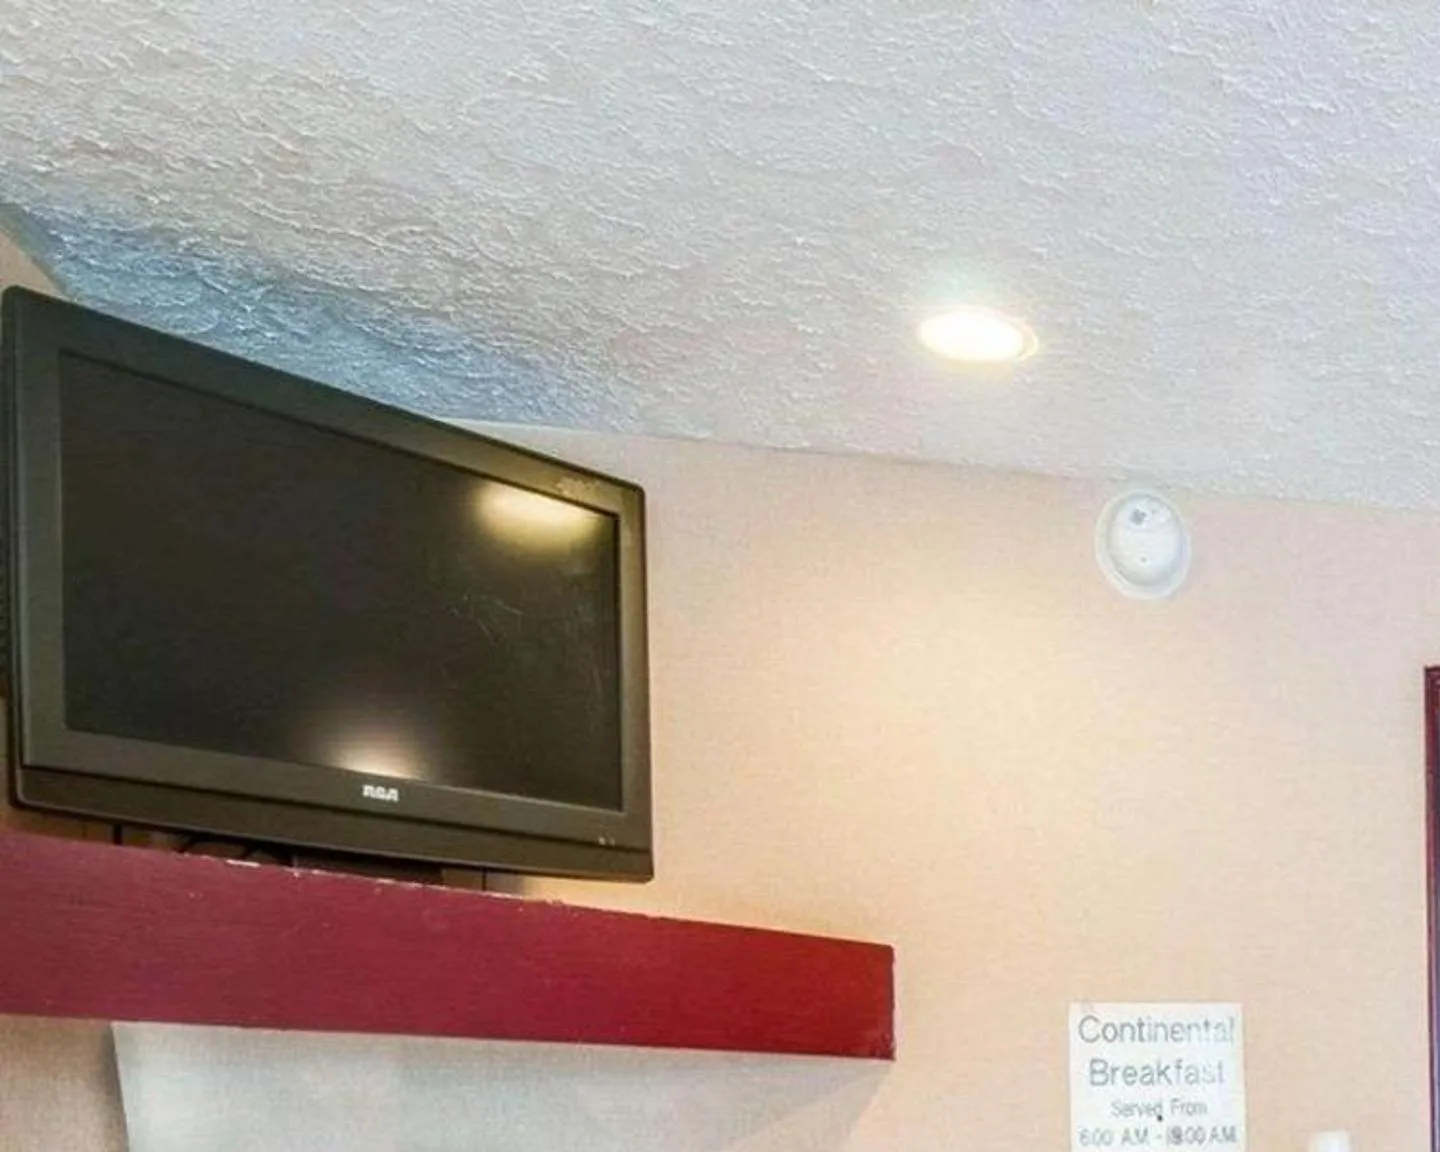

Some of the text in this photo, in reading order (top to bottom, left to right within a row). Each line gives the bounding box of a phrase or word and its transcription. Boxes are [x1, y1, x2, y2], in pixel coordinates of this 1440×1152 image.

[1078, 1014, 1235, 1044] Continental
[1089, 1057, 1224, 1086] Breakfast
[1111, 1098, 1208, 1117] Served From
